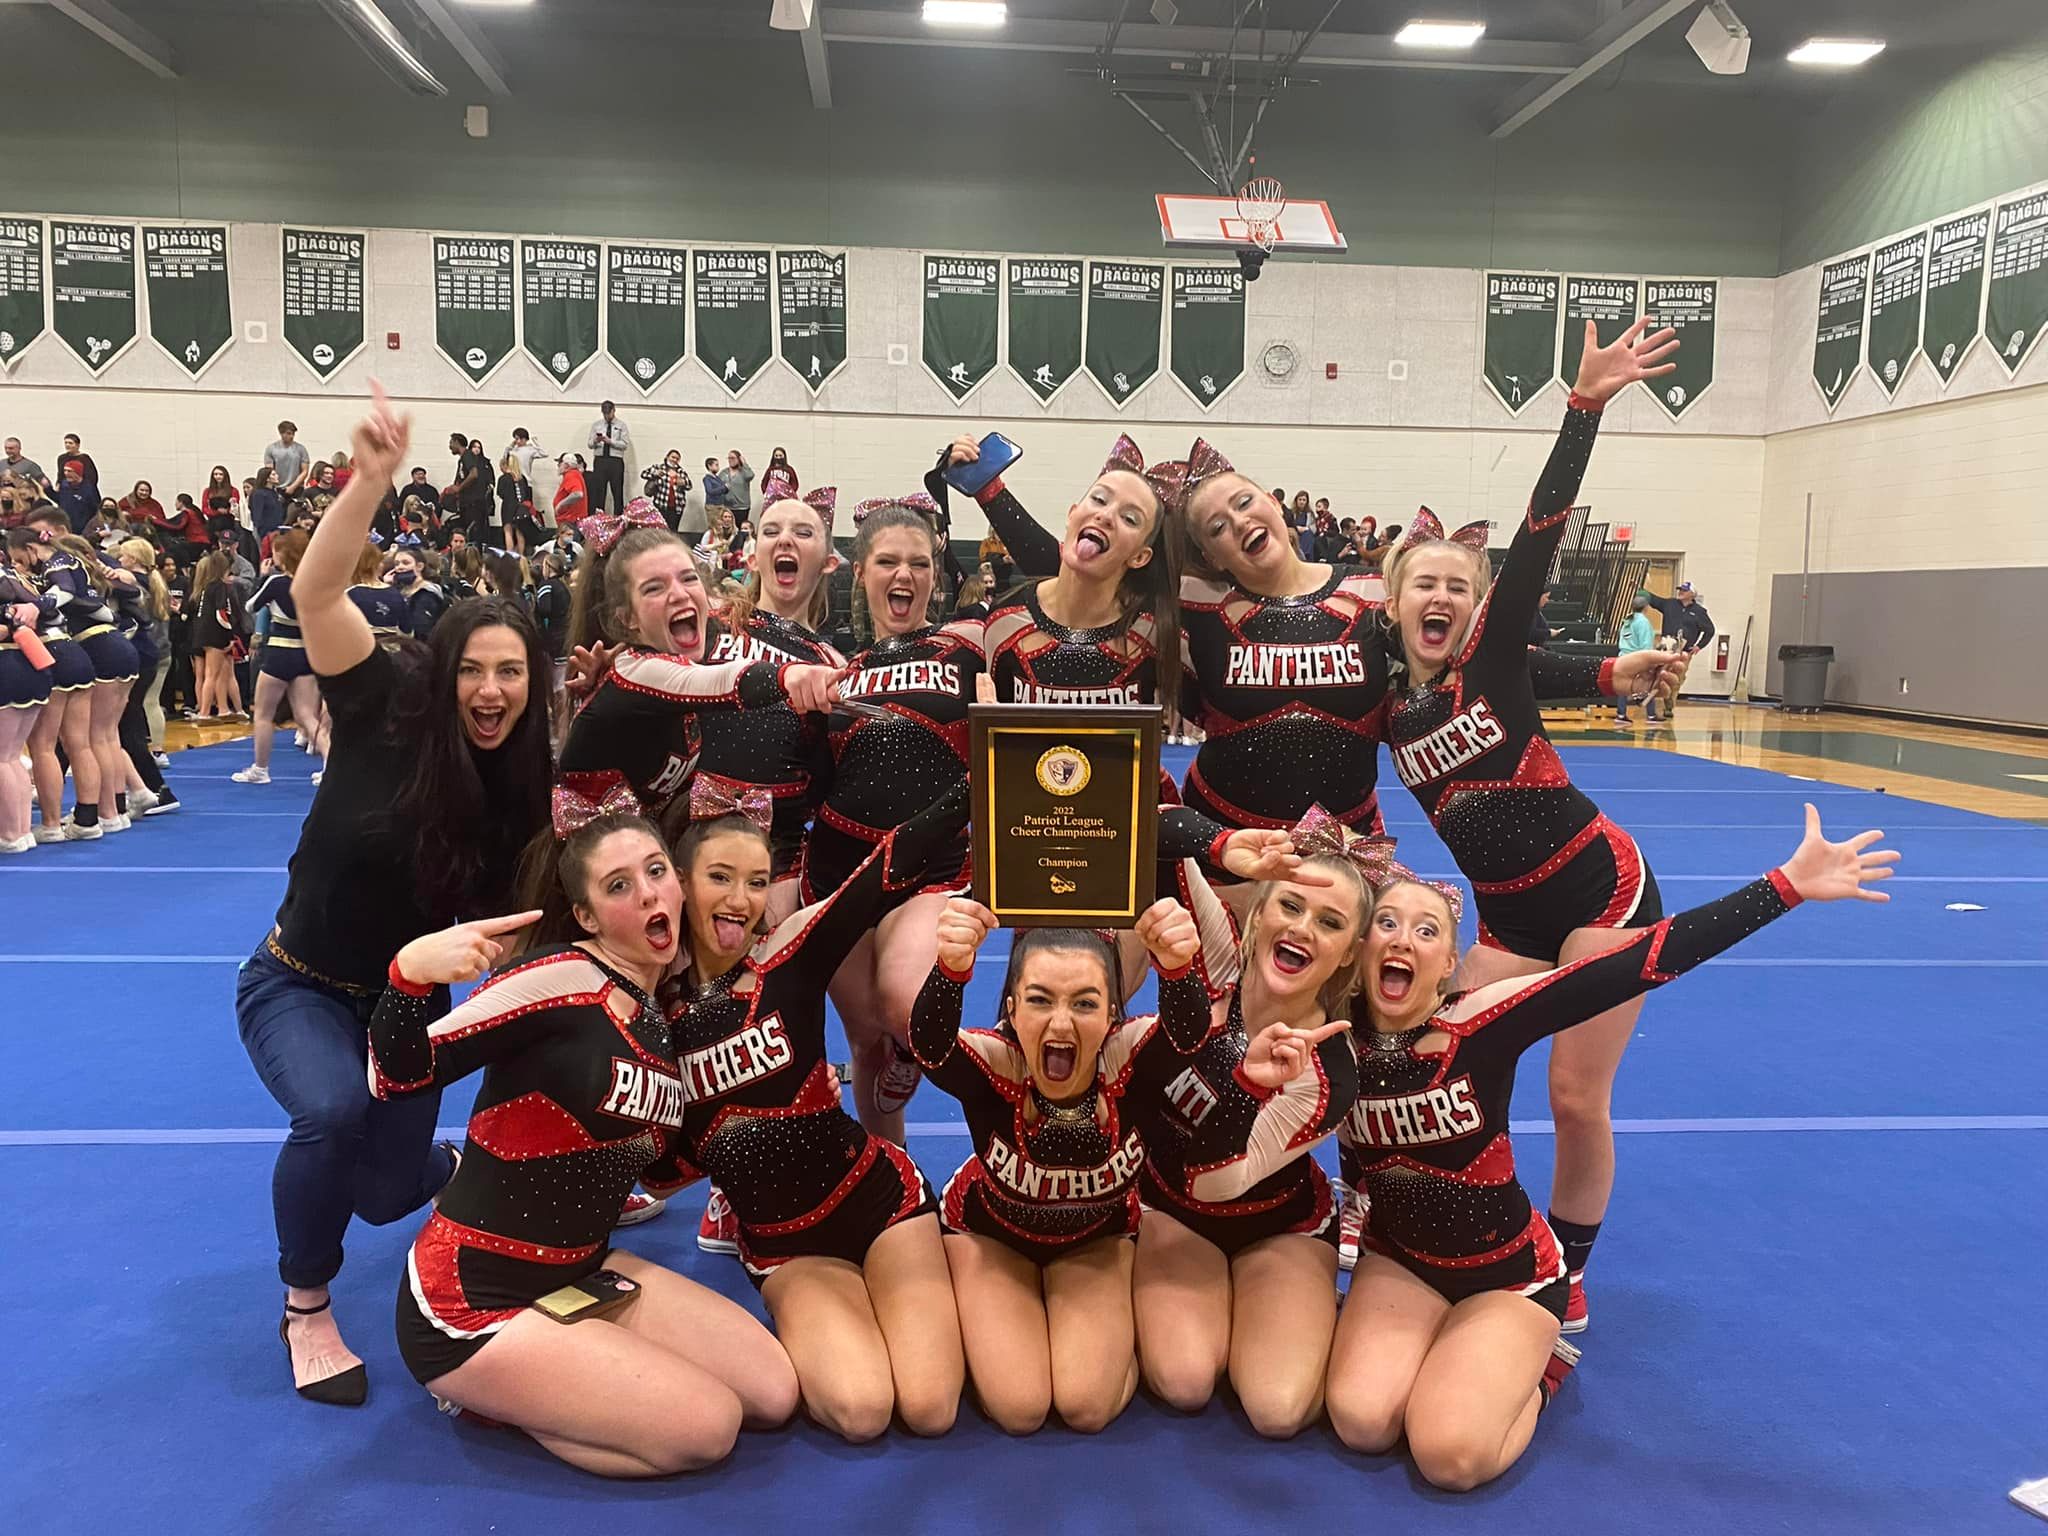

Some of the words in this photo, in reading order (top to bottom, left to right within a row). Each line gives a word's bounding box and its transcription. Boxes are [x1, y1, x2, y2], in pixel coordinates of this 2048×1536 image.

[1998, 199, 2048, 233] DRAGON
[54, 227, 131, 250] DRAGONS
[146, 232, 223, 251] DRAGONS
[1932, 216, 1987, 253] DRAGONS
[286, 235, 361, 258] DRAGONS
[437, 243, 511, 263] DRAGONS
[525, 246, 597, 268] DRAGONS
[1876, 238, 1925, 275] DRAGONS
[611, 251, 683, 273] DRAGONS
[696, 255, 768, 275] DRAGONS
[927, 262, 997, 283] DRAGONS
[1011, 265, 1080, 284] DRAGONS
[1092, 267, 1160, 289] DRAGONS
[1175, 272, 1242, 290] DRAGONS
[1823, 260, 1867, 290] DRAGONS
[1490, 279, 1556, 299] DRAGONS
[1569, 282, 1634, 303] DRAGONS
[1648, 286, 1712, 303] DRAGONS
[710, 633, 804, 664] PANT
[1225, 643, 1365, 688] PANTHERS
[1393, 701, 1504, 789] ANTHERS
[1052, 806, 1075, 815] 2022
[1010, 826, 1041, 837] Cheer
[1043, 826, 1118, 840] Championship
[1023, 815, 1061, 826] Patriot
[1063, 815, 1104, 829] League
[1038, 857, 1088, 869] Champion
[677, 1015, 792, 1104] NTHERS
[602, 1060, 685, 1129] PANTHE
[1348, 1079, 1481, 1146] NTHERS
[987, 1130, 1146, 1200] PANTHERS
